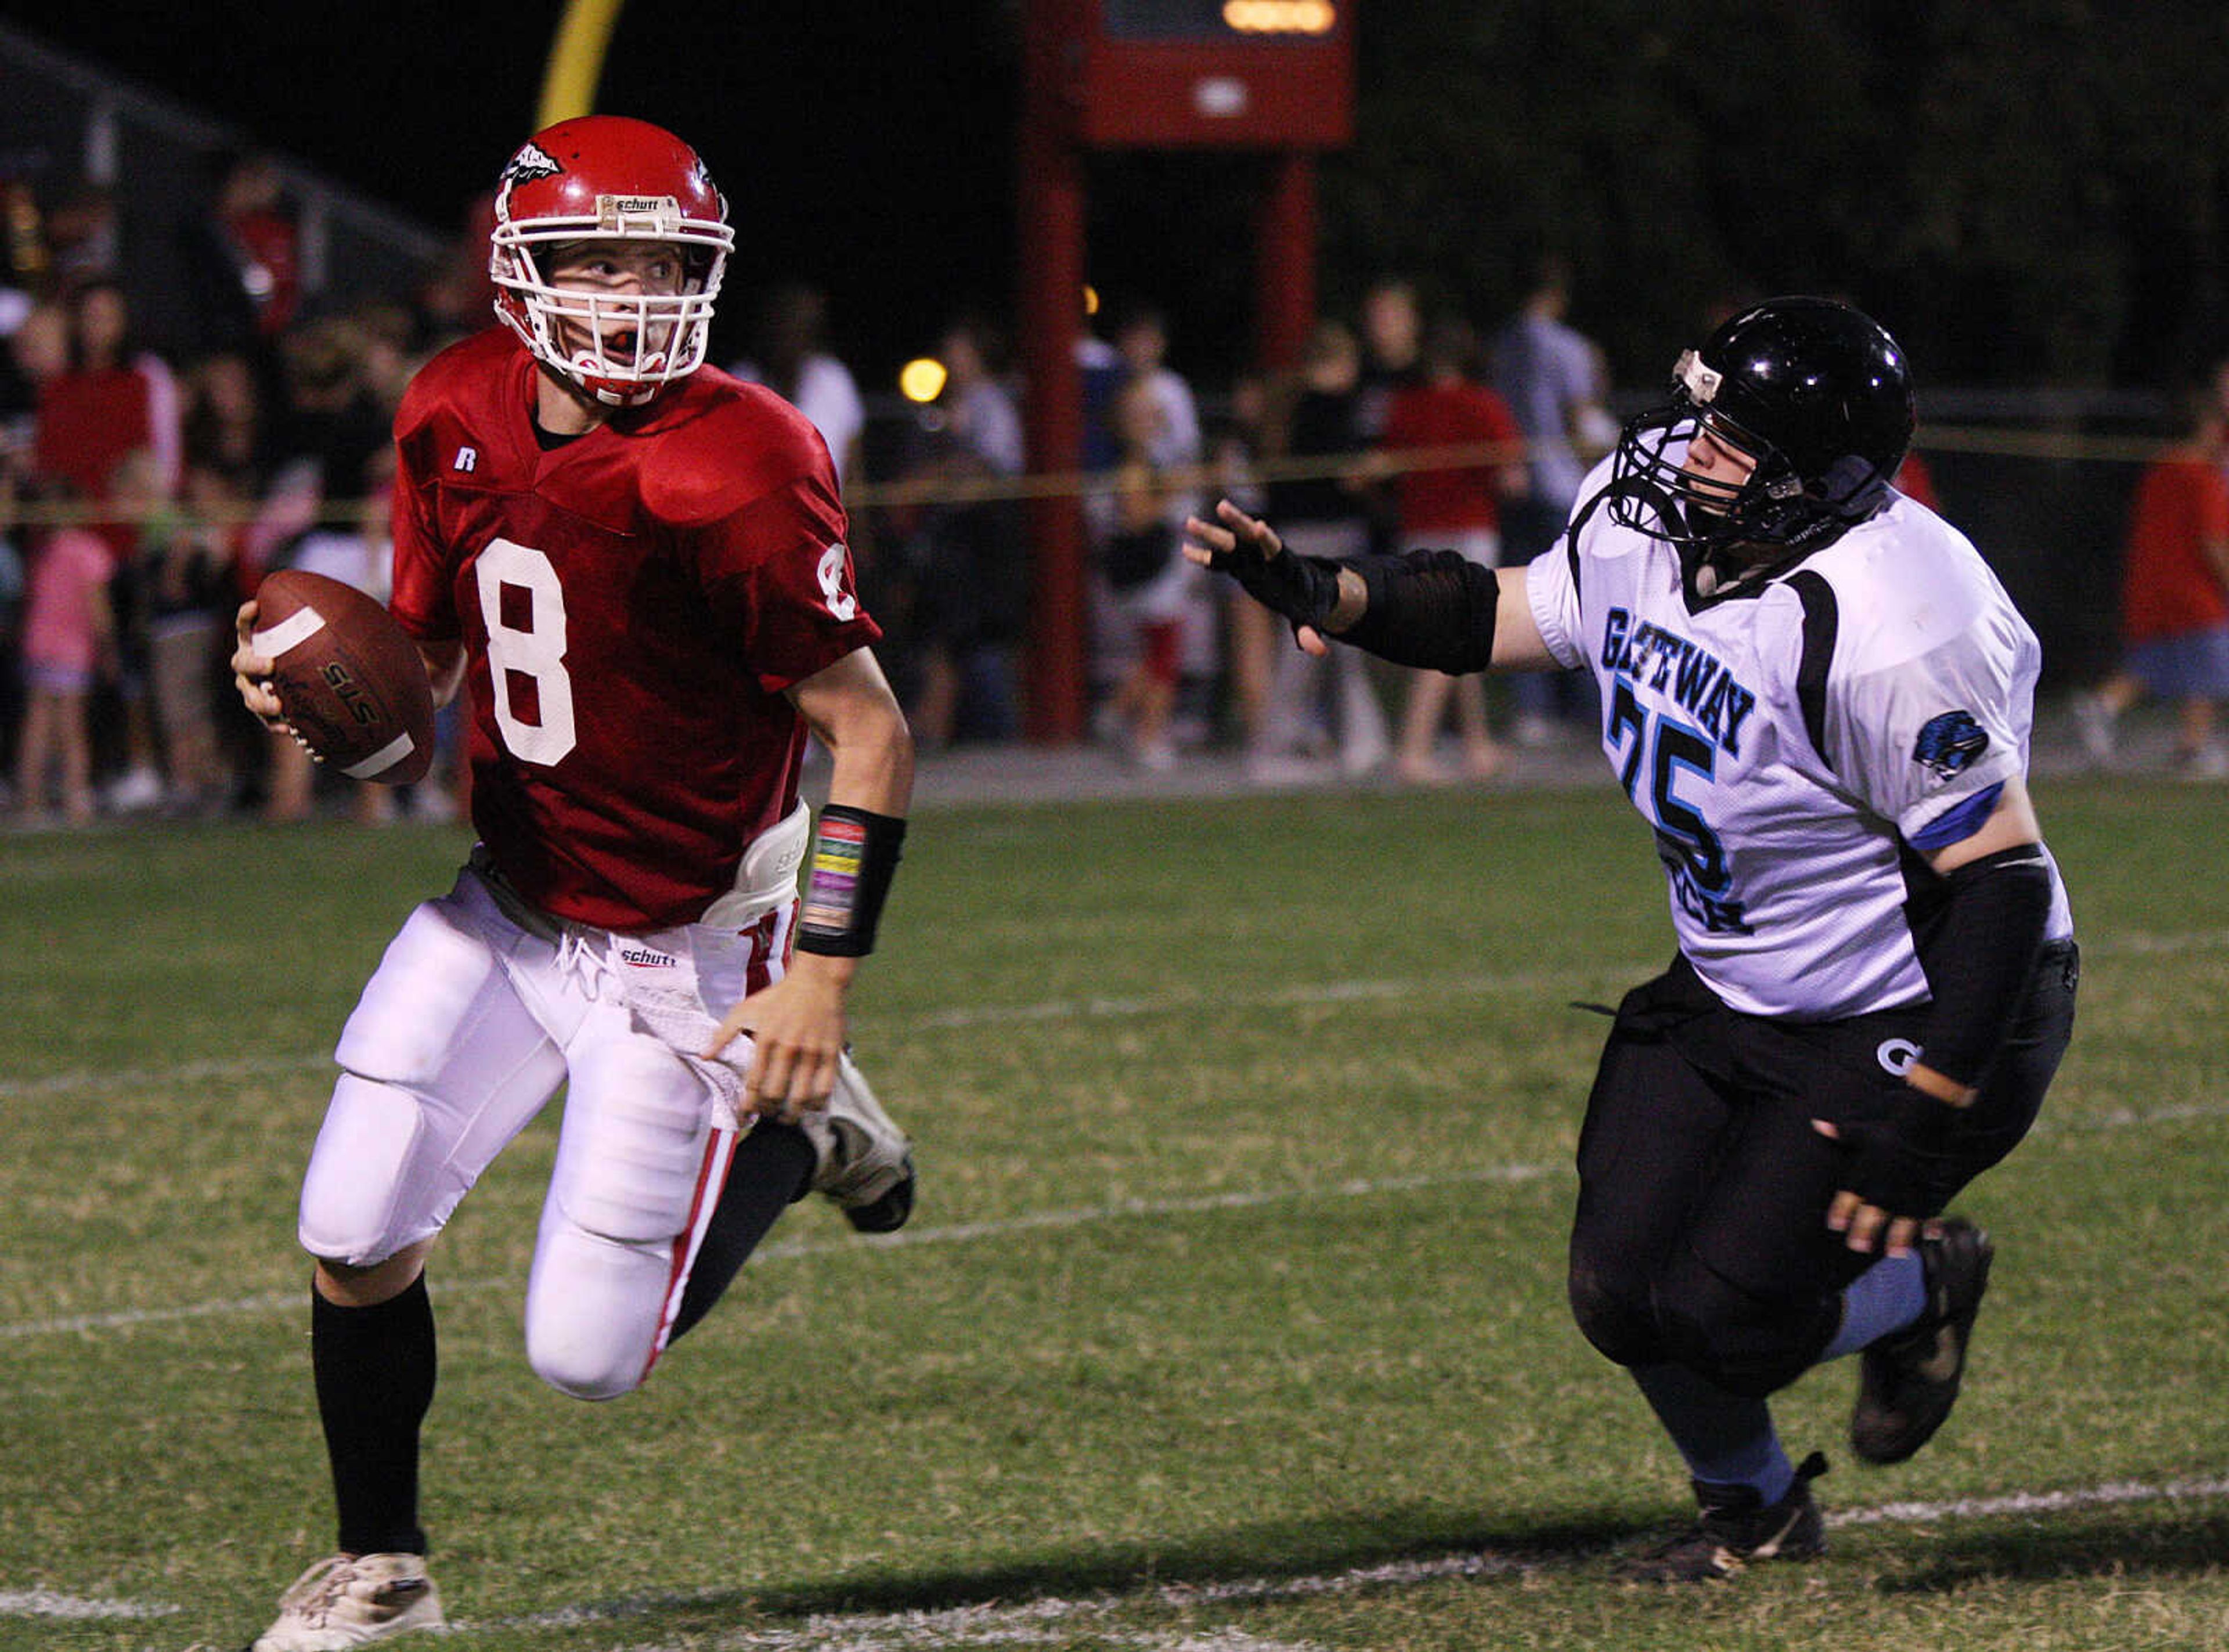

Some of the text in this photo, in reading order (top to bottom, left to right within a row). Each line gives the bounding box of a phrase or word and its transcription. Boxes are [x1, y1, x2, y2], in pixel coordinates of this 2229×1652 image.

[617, 198, 659, 211] schutt
[454, 446, 476, 471] R
[817, 542, 856, 621] 8
[475, 537, 576, 767] 8
[1607, 672, 1732, 901] 75
[622, 948, 677, 968] schutt
[1877, 1038, 1923, 1076] G
